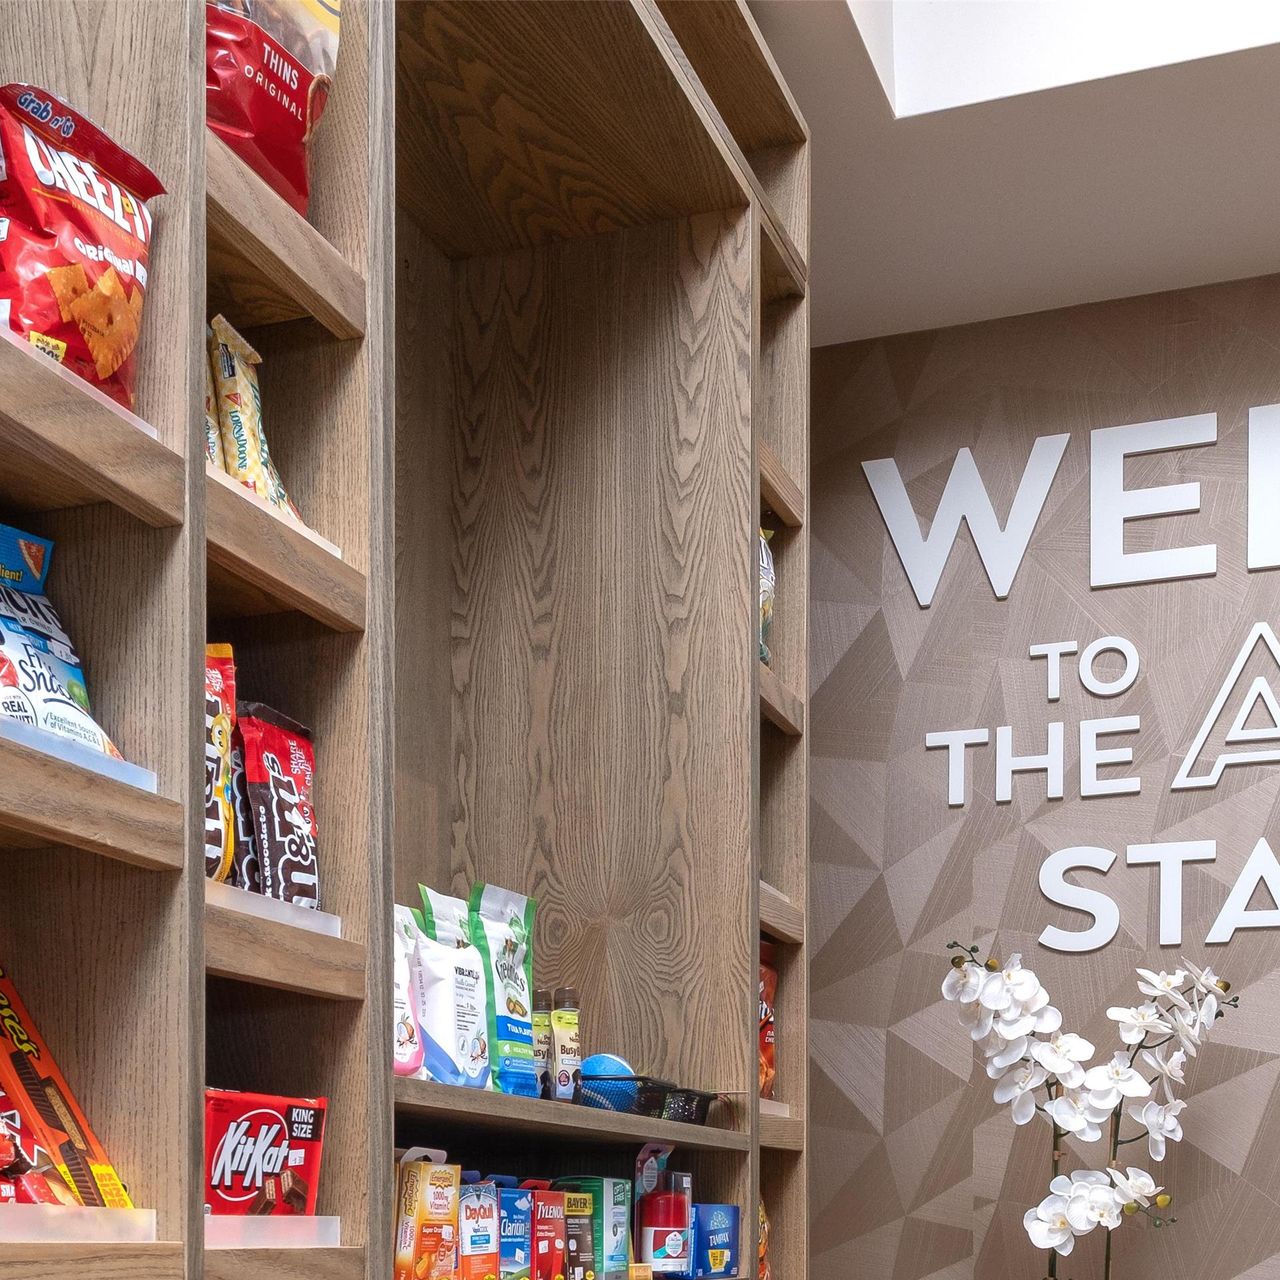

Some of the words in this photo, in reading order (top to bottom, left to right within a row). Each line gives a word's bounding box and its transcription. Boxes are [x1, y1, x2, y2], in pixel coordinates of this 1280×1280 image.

[262, 42, 299, 90] THINS
[244, 64, 303, 121] ORIGINAL
[17, 93, 52, 122] Grab
[1030, 636, 1140, 701] TO
[2, 701, 27, 714] REAL
[925, 716, 1141, 807] THE
[292, 1108, 314, 1123] KING
[292, 1124, 313, 1138] SIZE
[211, 1121, 289, 1188] KitKat
[537, 1202, 565, 1219] TYLENOL
[567, 1198, 588, 1209] BAYER
[464, 1204, 494, 1224] DayQuil
[501, 1219, 525, 1236] Claritin
